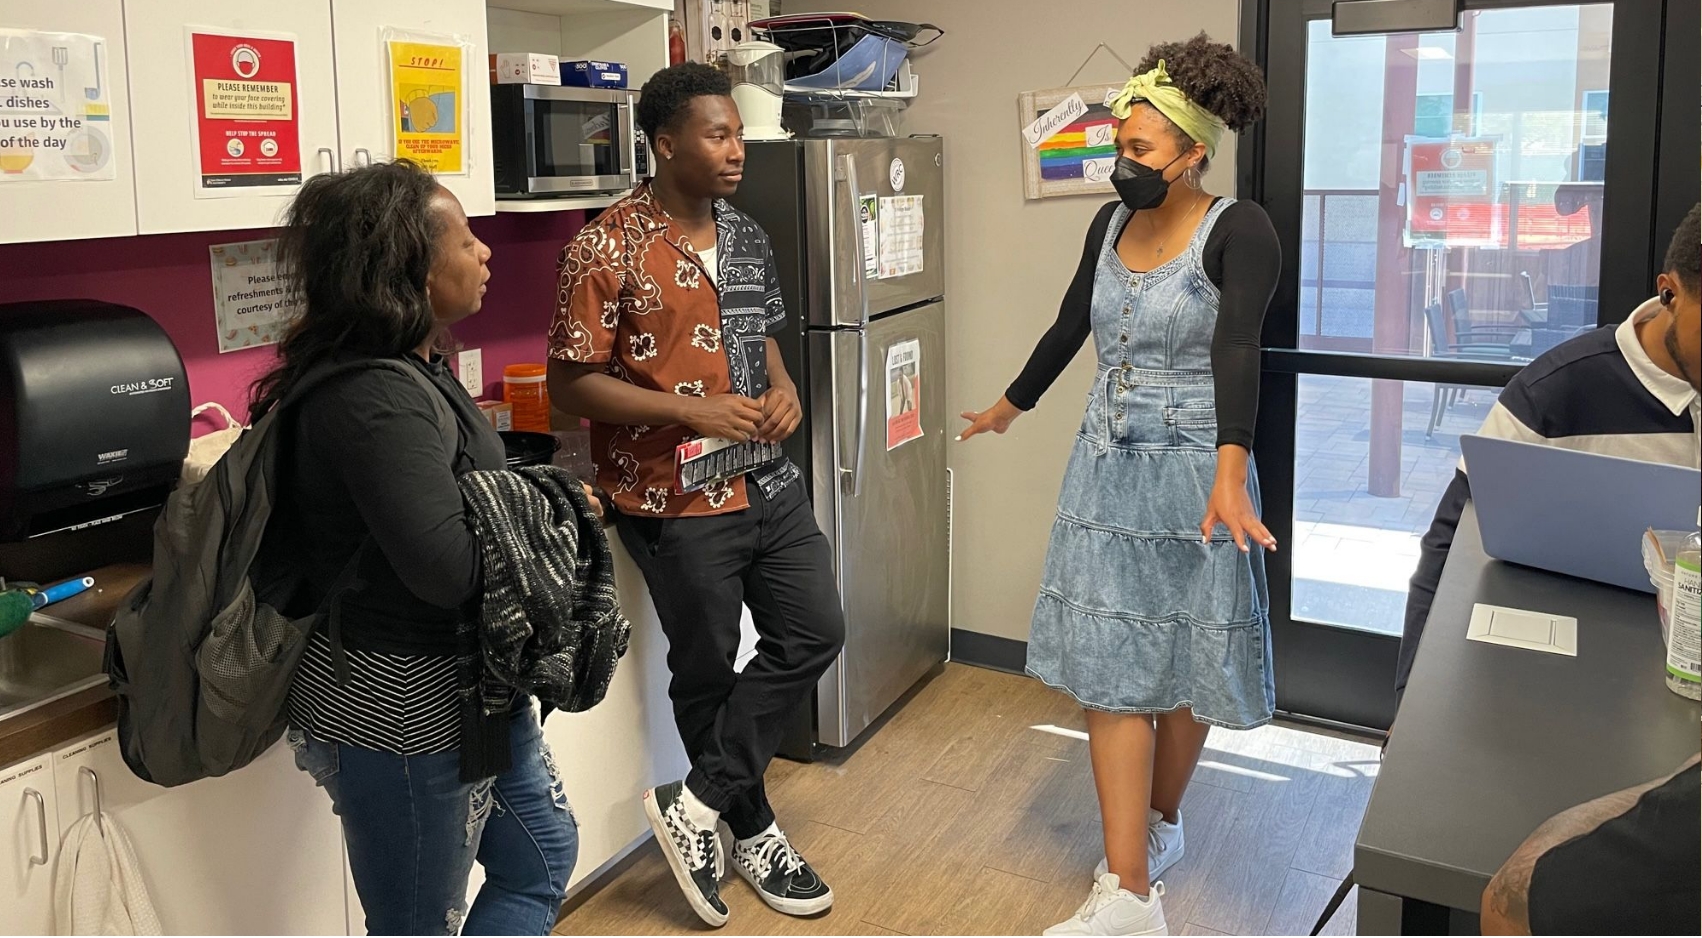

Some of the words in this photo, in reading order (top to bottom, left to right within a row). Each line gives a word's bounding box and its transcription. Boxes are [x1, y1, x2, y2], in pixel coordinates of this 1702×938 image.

[411, 56, 444, 67] STOP!
[0, 78, 16, 88] se
[20, 77, 54, 89] wash
[217, 83, 240, 92] PLEASE
[242, 84, 279, 93] REMEMBER
[6, 95, 50, 109] dishes
[247, 94, 260, 103] face
[261, 95, 285, 104] covering
[0, 119, 9, 128] u
[14, 119, 37, 128] use
[41, 116, 56, 131] by
[59, 117, 81, 128] the
[1029, 99, 1083, 144] Inherently
[1088, 124, 1111, 146] Is
[0, 136, 15, 148] of
[17, 136, 39, 148] the
[43, 136, 67, 150] day
[1085, 160, 1113, 181] Quee
[247, 274, 276, 285] Please
[227, 287, 284, 302] refreshments
[236, 303, 273, 315] courtesy
[274, 300, 283, 308] of
[110, 382, 139, 394] CLEAN
[141, 381, 148, 390] &
[148, 377, 174, 389] SOFT
[62, 746, 87, 759] CLEANING
[88, 737, 112, 749] SUPPLIES
[0, 775, 16, 784] ANING
[18, 764, 42, 777] SUPPLIES
